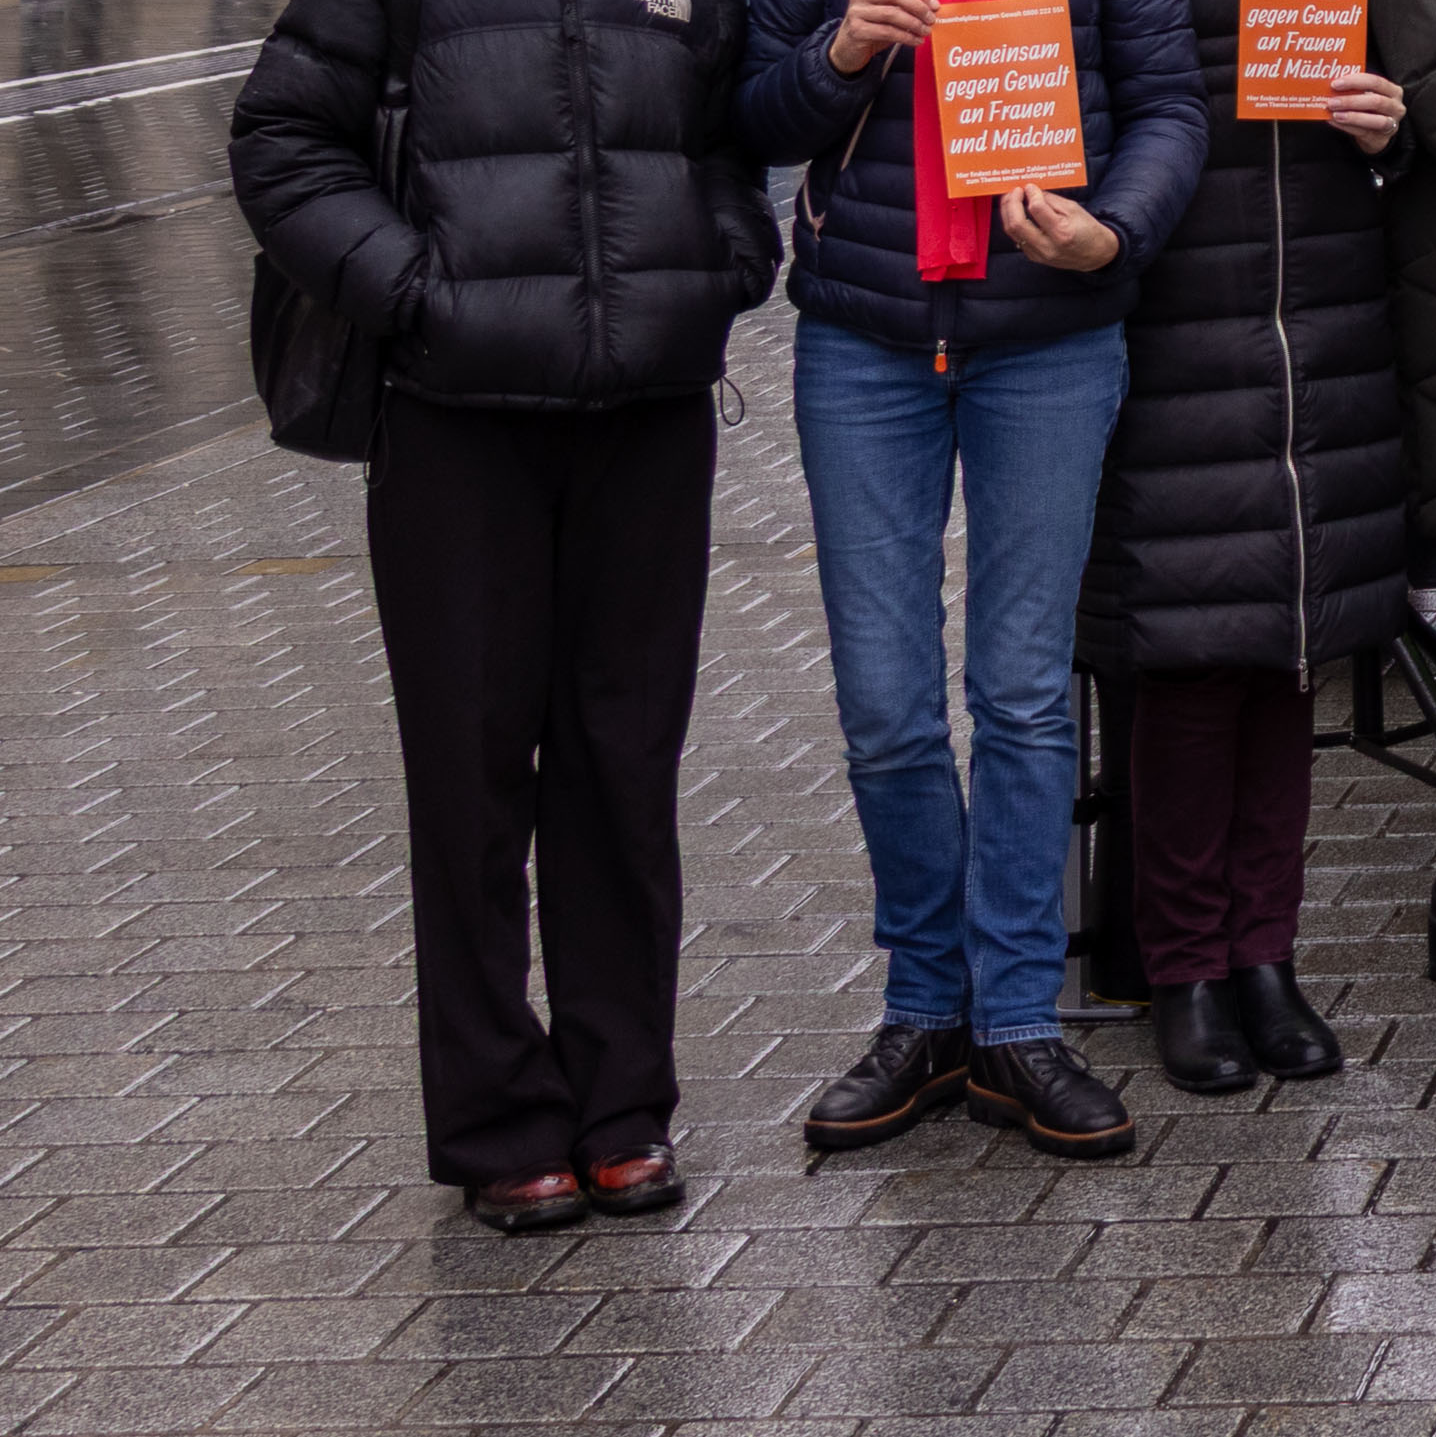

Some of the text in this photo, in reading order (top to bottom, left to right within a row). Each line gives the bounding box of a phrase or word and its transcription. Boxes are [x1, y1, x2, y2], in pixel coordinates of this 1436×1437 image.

[647, 2, 677, 18] FACE
[1245, 4, 1362, 27] gegen Gewalt
[1256, 31, 1346, 51] an Frauen
[948, 42, 1059, 67] Gemeinsam
[1244, 57, 1360, 78] und Mädchen
[944, 64, 1069, 101] gegen Gewalt
[958, 100, 1055, 124] an Frauen
[949, 124, 1076, 154] und Mädchen
